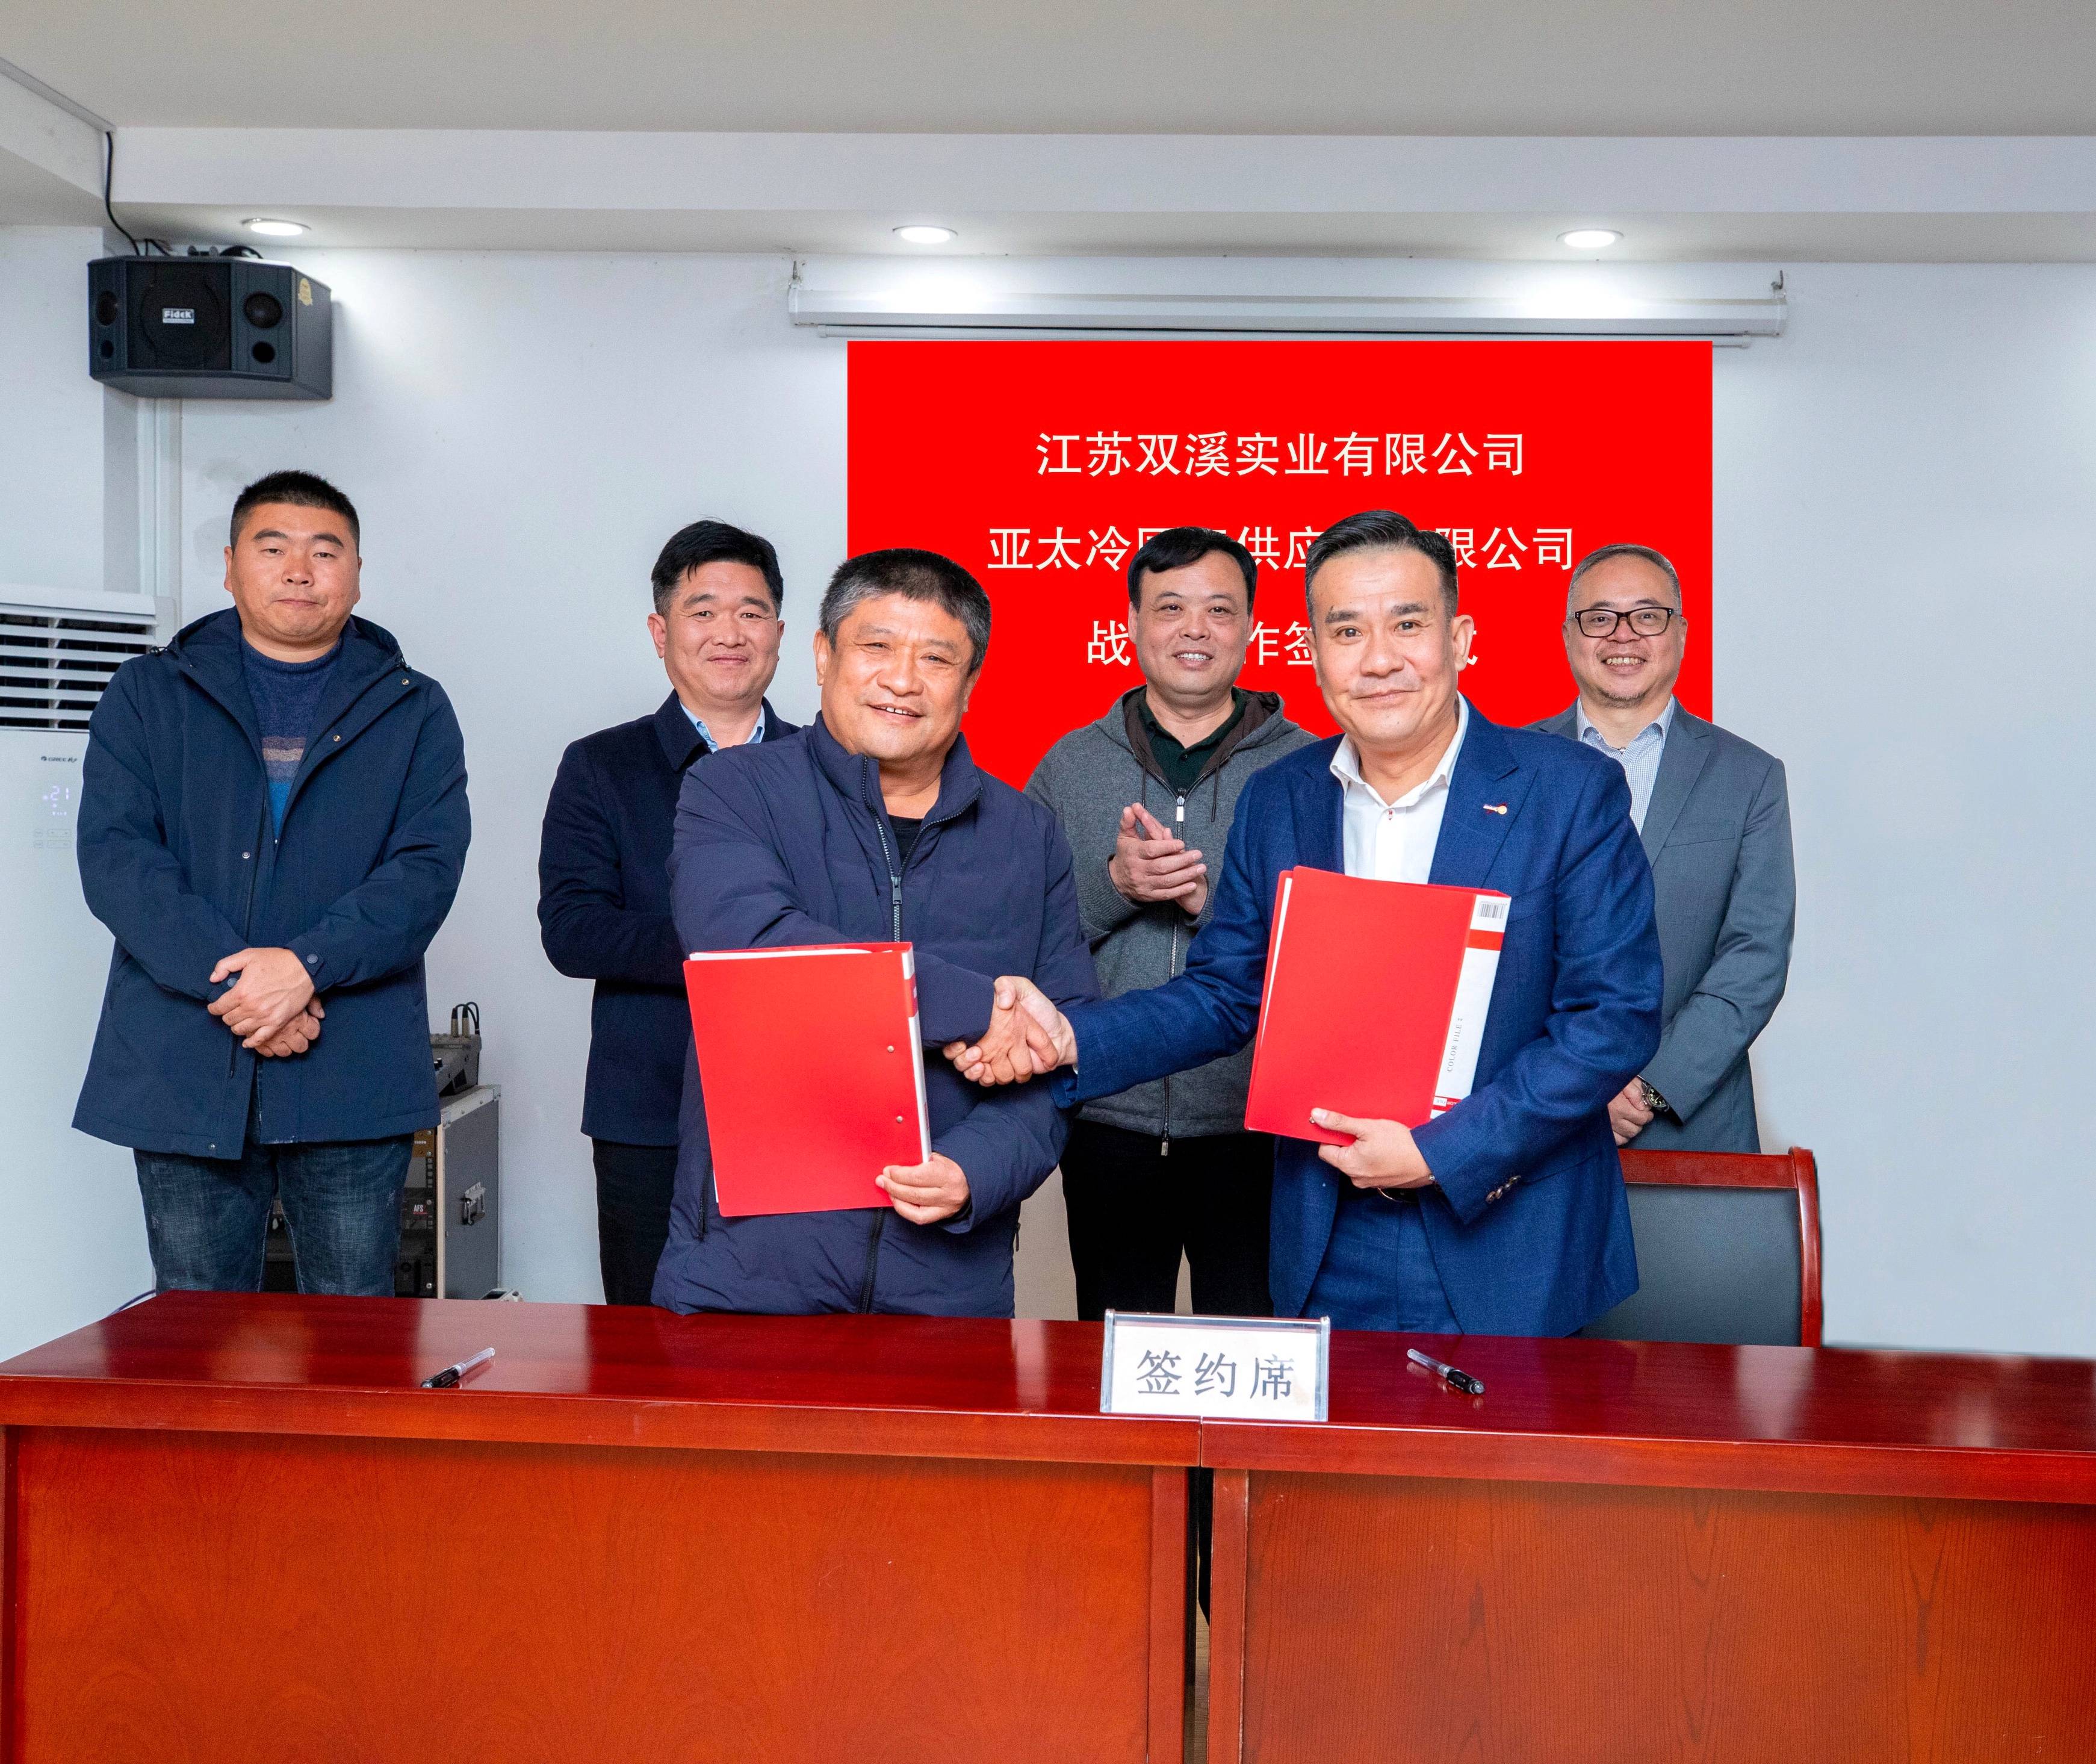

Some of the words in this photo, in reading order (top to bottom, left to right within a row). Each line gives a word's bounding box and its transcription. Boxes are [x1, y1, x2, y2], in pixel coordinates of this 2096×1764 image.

[1036, 430, 1523, 477] 江苏双溪实业有限公司
[987, 526, 1574, 571] 亚太冷供应限公司
[1446, 1046, 1457, 1072] COLOR
[1453, 1025, 1462, 1042] FILE
[1136, 1350, 1294, 1400] 签约席
